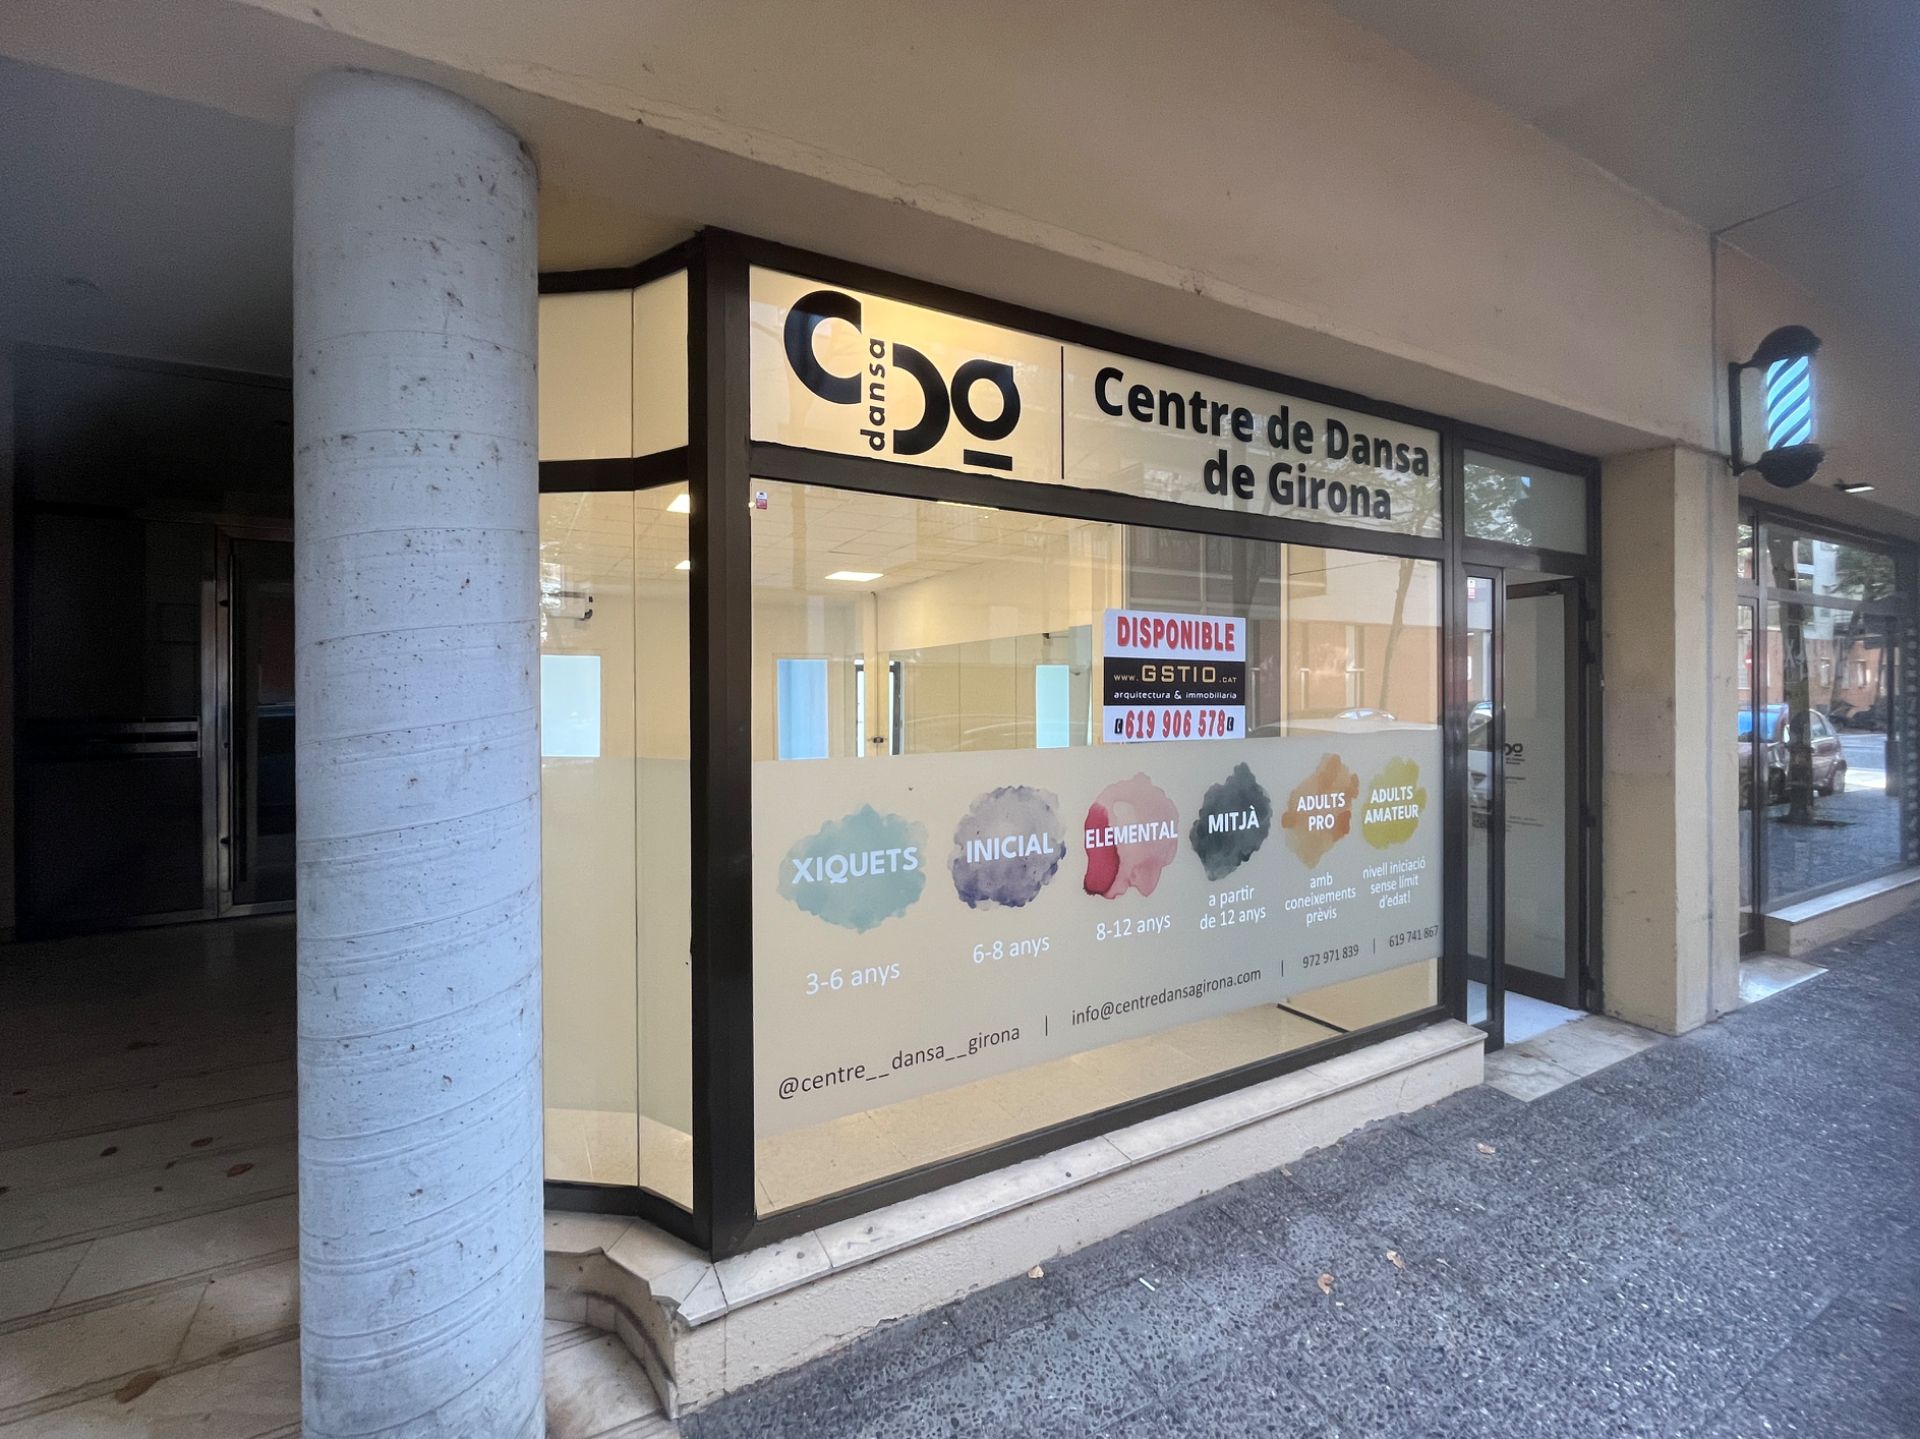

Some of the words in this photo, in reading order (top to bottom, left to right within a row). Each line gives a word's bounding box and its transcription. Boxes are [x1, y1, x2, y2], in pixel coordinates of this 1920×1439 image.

[860, 338, 885, 451] dansa
[1094, 366, 1254, 443] Centre
[1267, 405, 1314, 455] de
[1326, 418, 1429, 477] Dansa
[1204, 449, 1255, 500] de
[1268, 462, 1391, 520] Girona
[1117, 616, 1235, 652] DISPONIBLE
[1113, 691, 1171, 699] arquitectura
[1174, 690, 1182, 700] &
[1125, 710, 1155, 739] 619
[1162, 709, 1192, 738] 906
[1198, 709, 1225, 737] 578
[1297, 792, 1346, 812] ADULTS
[1370, 786, 1413, 804] ADULTS
[1208, 805, 1260, 834] MITJÀ
[1308, 815, 1335, 832] PRO
[1364, 804, 1419, 824] AMATEUR
[966, 833, 1054, 863] INICIAL
[1085, 820, 1178, 849] ELEMENTAL
[791, 847, 919, 884] XIQUETS
[1362, 861, 1388, 879] nivell
[1310, 871, 1333, 889] amb
[1370, 880, 1397, 895] sense
[1208, 892, 1217, 907] a
[1220, 885, 1255, 909] partir
[1284, 887, 1357, 911] coneixements
[1096, 917, 1132, 942] 8-12
[1137, 911, 1172, 934] anys
[1199, 913, 1217, 930] de
[1220, 909, 1236, 926] 12
[1239, 904, 1267, 922] anys
[973, 940, 1004, 964] 6-8
[1009, 935, 1051, 959] anys
[1389, 932, 1405, 948] 619
[1407, 929, 1422, 943] 741
[1303, 953, 1321, 969] 972
[1323, 948, 1340, 964] 971
[1342, 943, 1359, 959] 839
[806, 967, 844, 996] 3-6
[851, 961, 901, 987] anys
[1071, 968, 1262, 1026] info@centredansagirona.com
